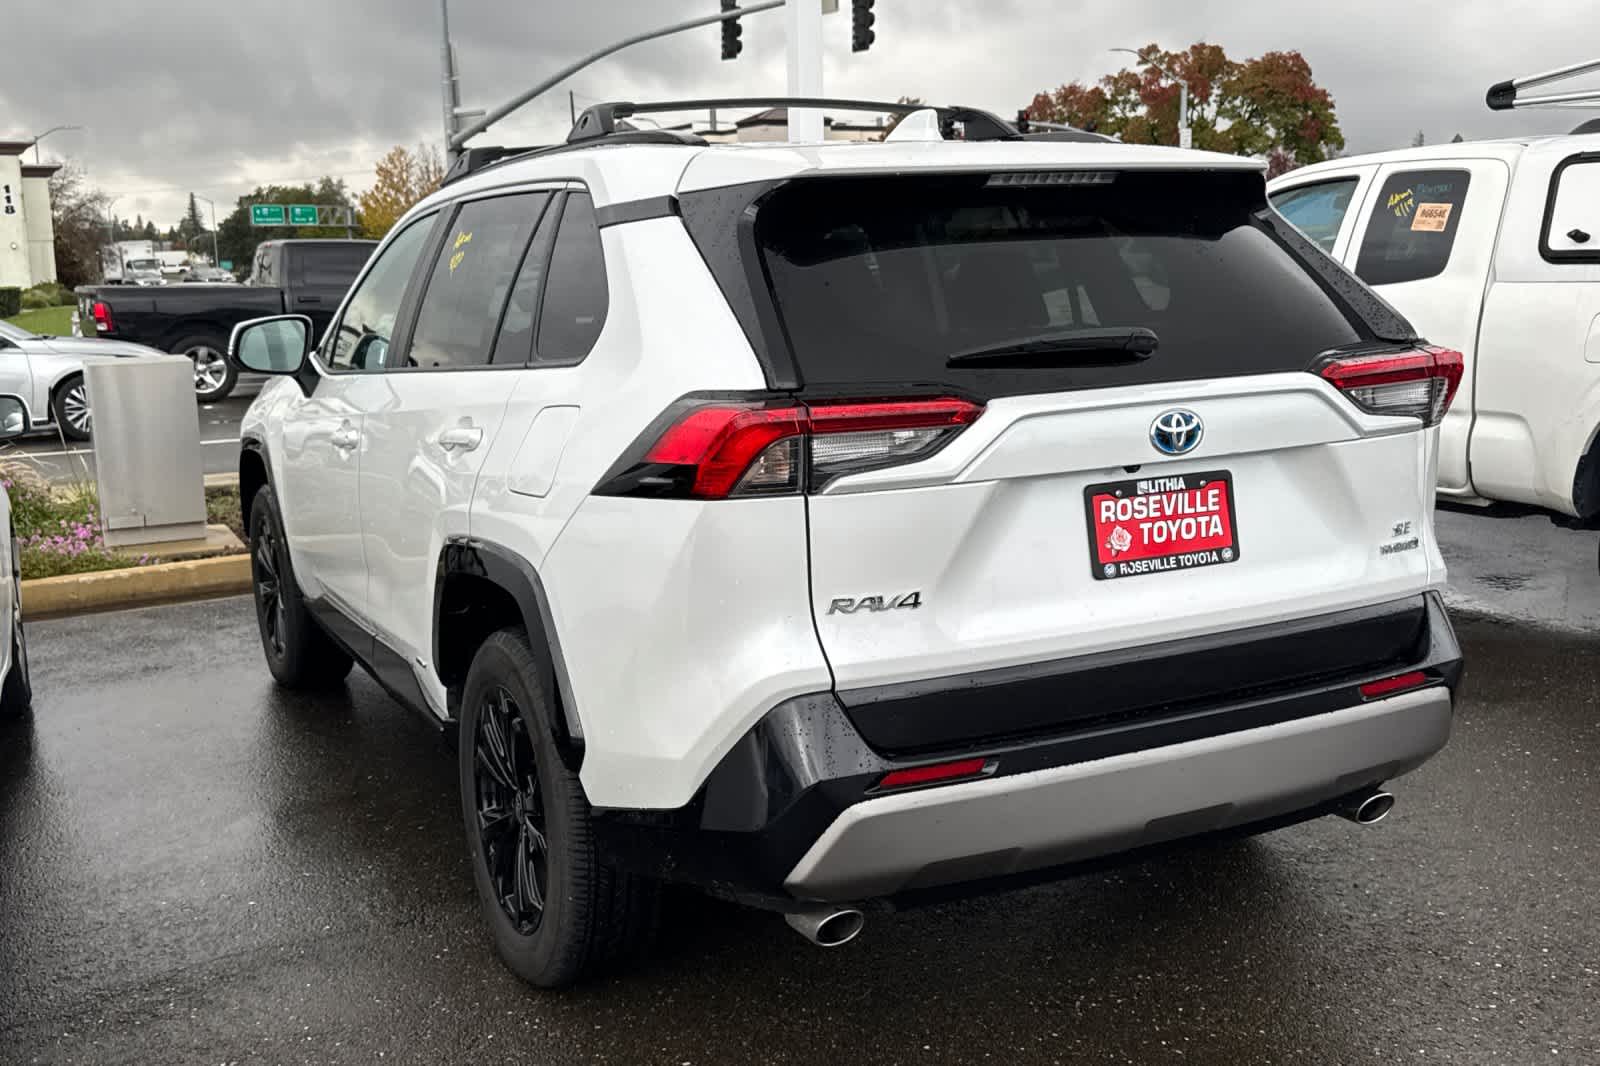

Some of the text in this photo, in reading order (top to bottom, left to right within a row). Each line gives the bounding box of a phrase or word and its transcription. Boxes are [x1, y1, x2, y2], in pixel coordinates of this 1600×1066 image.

[4, 184, 16, 215] 118
[1149, 477, 1186, 494] LITHIA
[1100, 489, 1220, 523] ROSEVILLE
[1139, 515, 1224, 545] TOYOTA
[1119, 552, 1219, 575] ROSEVILLE TOYOTA
[825, 591, 922, 615] RAV4
